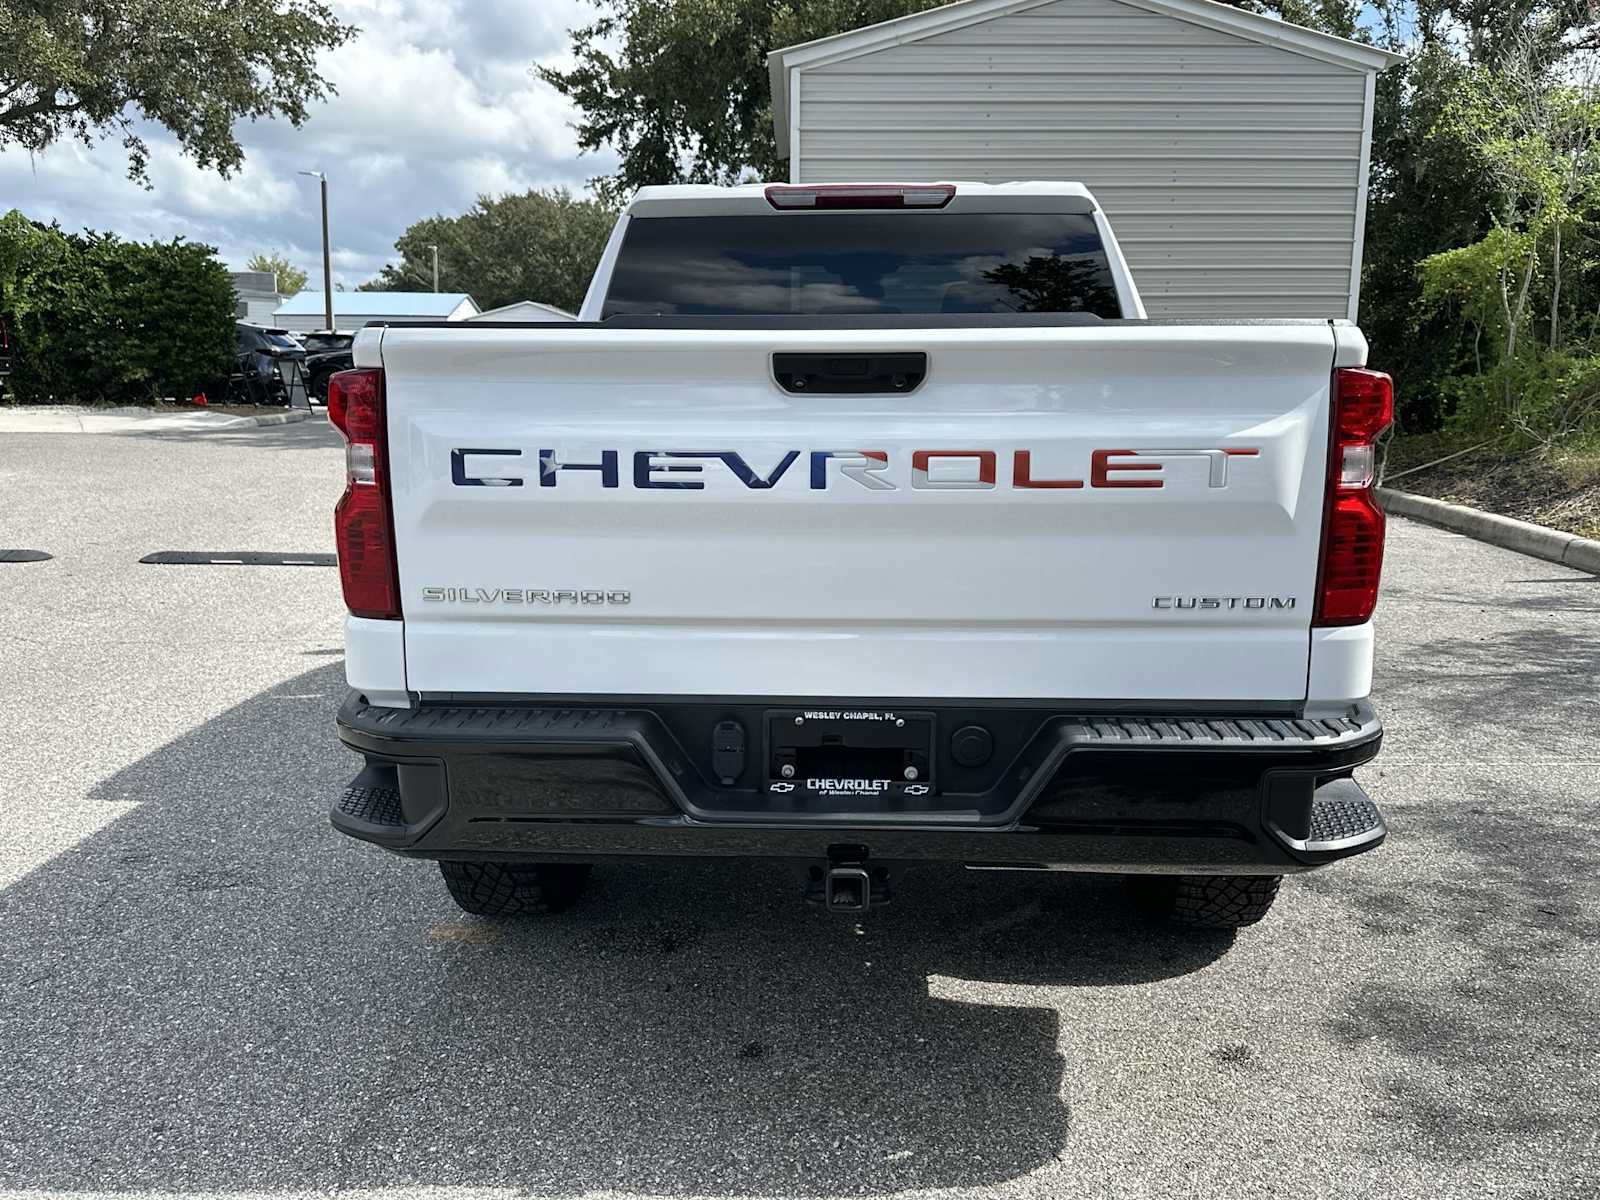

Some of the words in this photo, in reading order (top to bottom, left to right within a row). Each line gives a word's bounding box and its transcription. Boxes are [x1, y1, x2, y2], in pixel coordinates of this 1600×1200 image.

[450, 448, 1260, 490] CHEVROLET
[422, 587, 632, 605] SILVERADO
[1151, 596, 1297, 609] CUSTOM
[804, 711, 841, 719] WESLEY
[843, 712, 882, 721] CHAPEL,
[884, 712, 896, 720] FL
[806, 778, 891, 791] CHEVROLET
